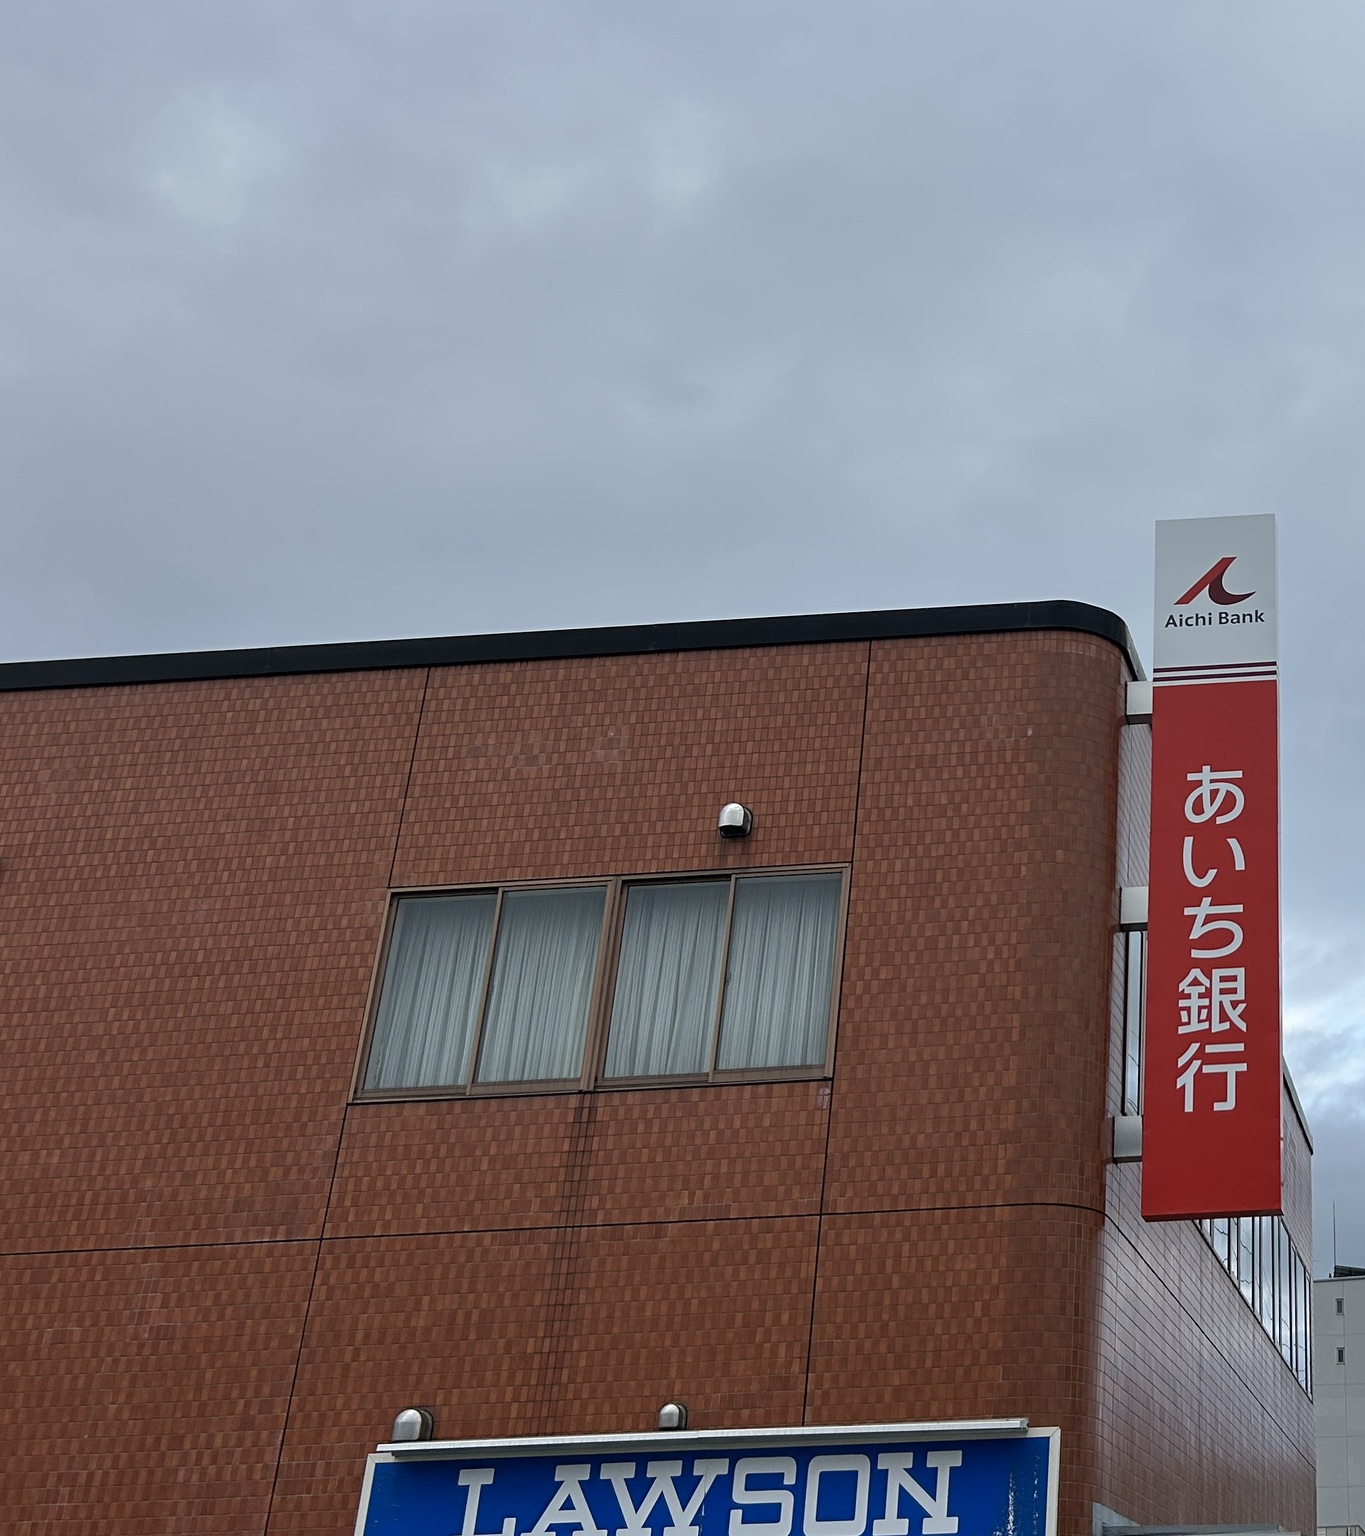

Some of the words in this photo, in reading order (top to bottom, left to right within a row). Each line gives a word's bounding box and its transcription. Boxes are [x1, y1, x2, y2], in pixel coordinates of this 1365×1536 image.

[1164, 612, 1212, 628] Aichi
[1218, 610, 1265, 625] Bank
[1176, 765, 1247, 1113] あいち銀行
[452, 1450, 962, 1536] LAWSON
